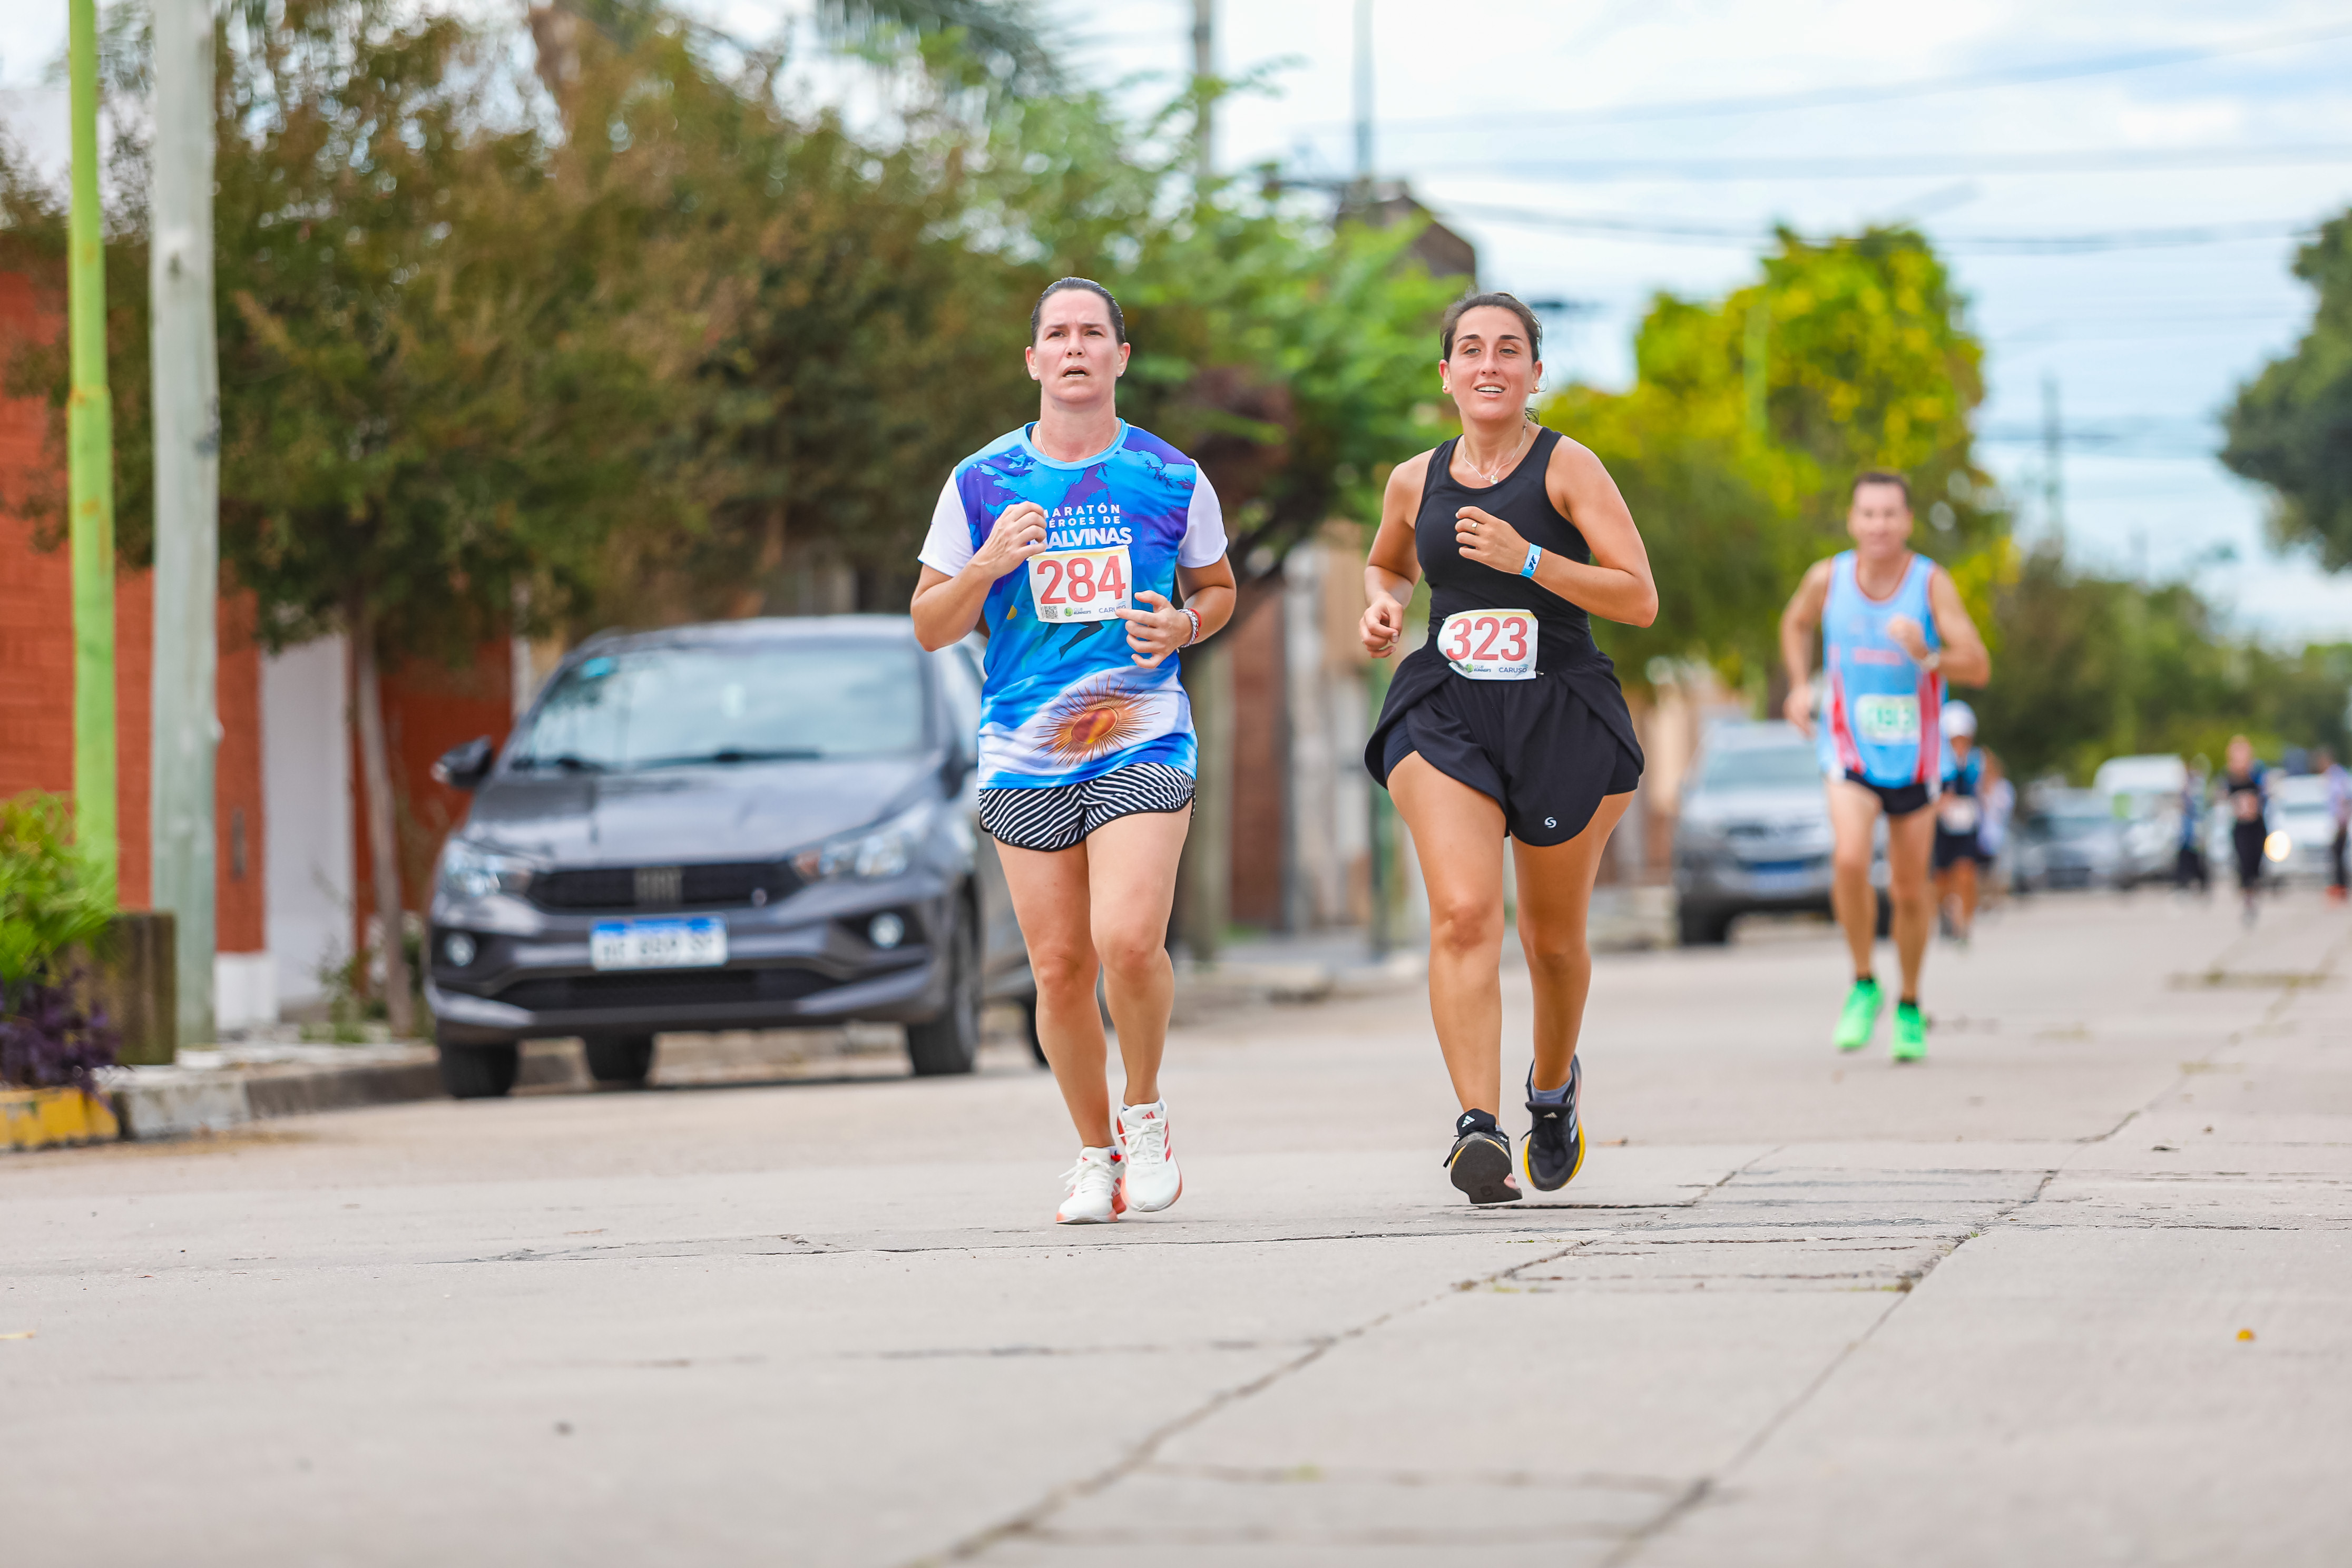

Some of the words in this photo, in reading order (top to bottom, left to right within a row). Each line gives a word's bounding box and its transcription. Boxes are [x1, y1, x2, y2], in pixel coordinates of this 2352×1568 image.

[1049, 516, 1095, 528] ÉROES
[1103, 516, 1121, 524] DE
[1037, 555, 1126, 604] 284
[1446, 616, 1528, 661] 323
